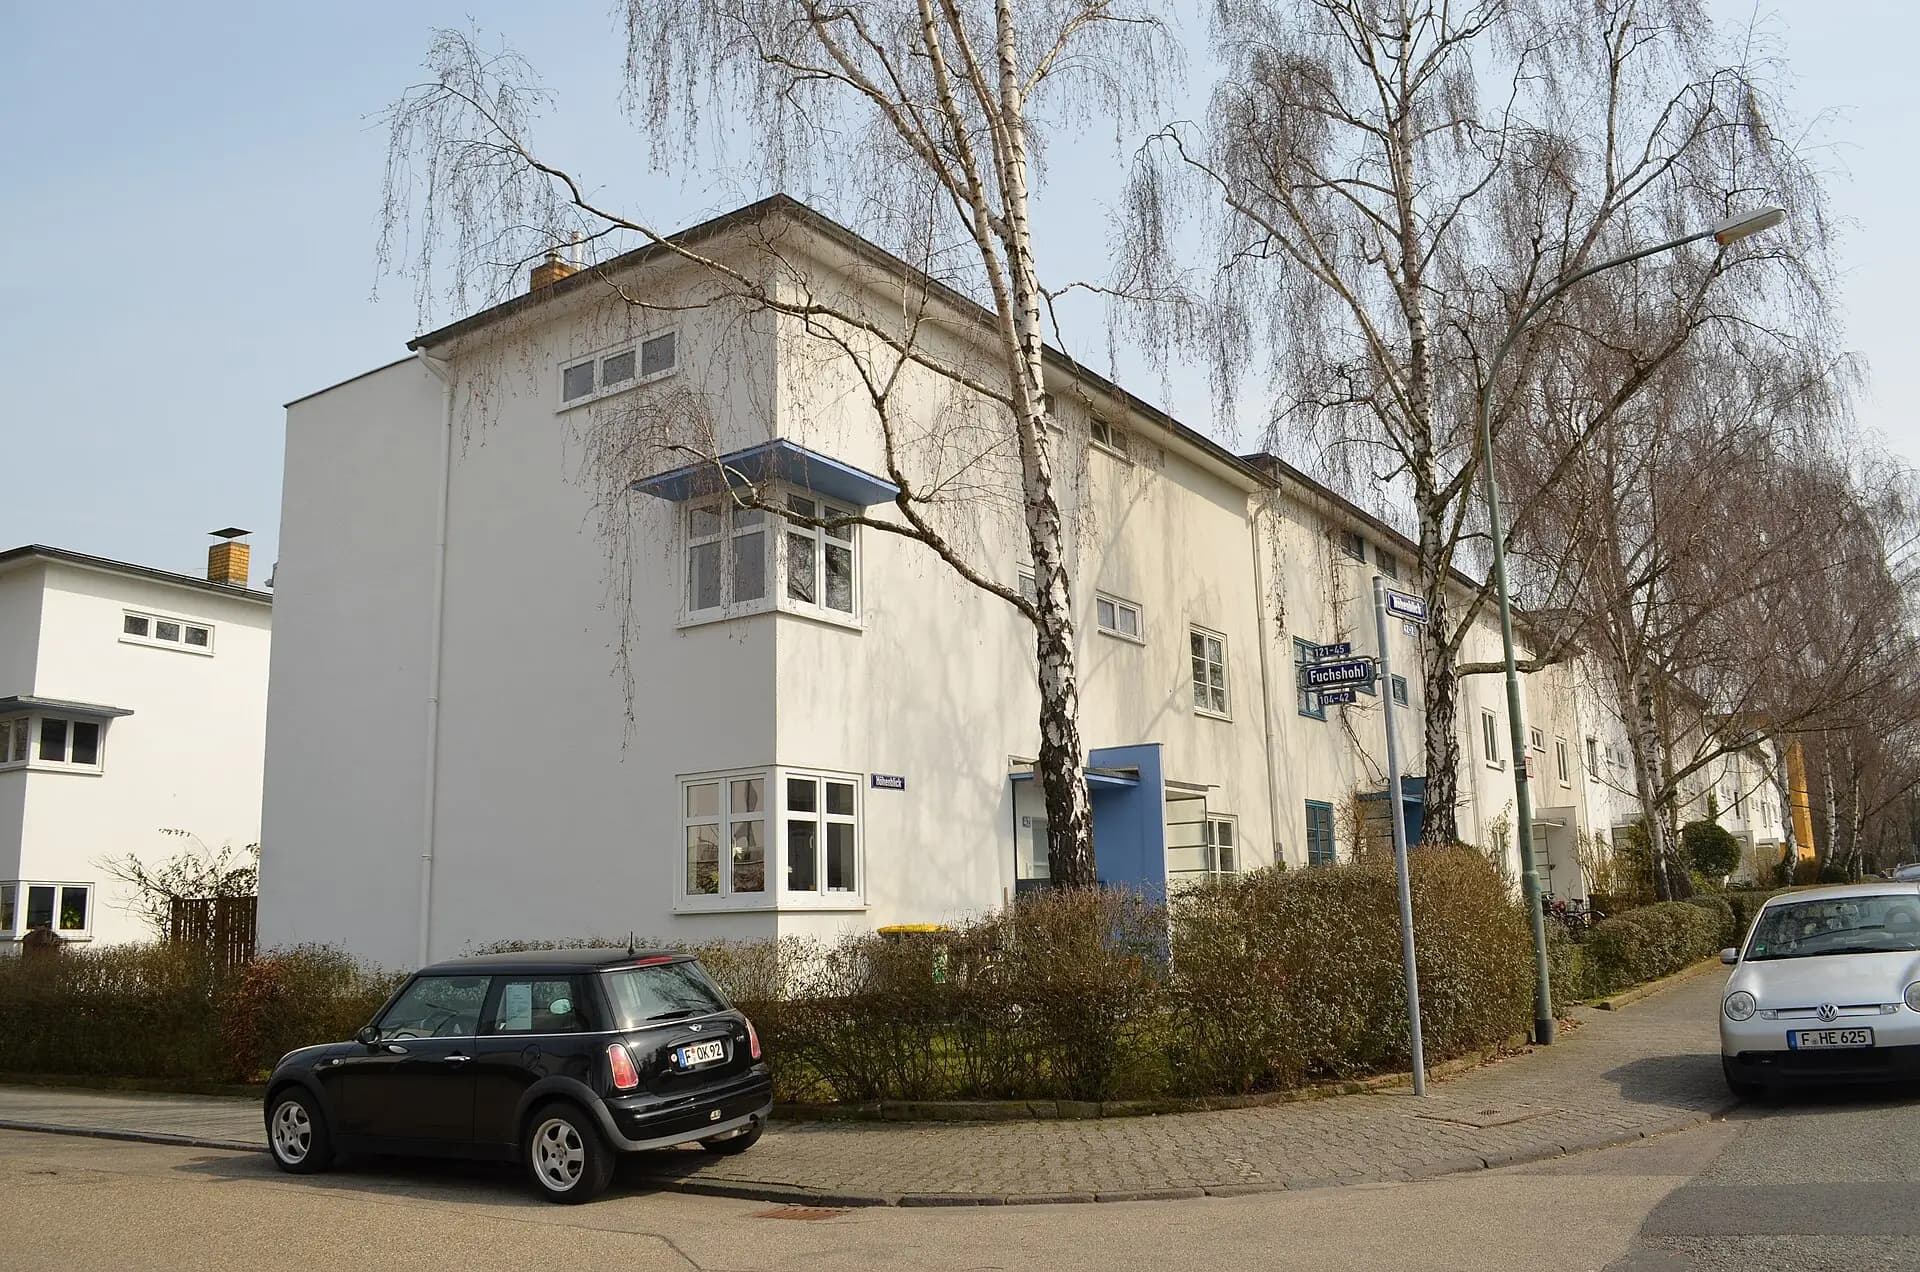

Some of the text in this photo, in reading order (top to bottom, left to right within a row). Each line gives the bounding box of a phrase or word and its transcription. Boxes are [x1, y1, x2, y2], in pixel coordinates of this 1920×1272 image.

[1315, 647, 1345, 657] 121-45
[1310, 664, 1365, 684] Fuchshohl
[1319, 692, 1350, 704] 104-42
[1817, 1003, 1838, 1021] VW
[1801, 1030, 1866, 1045] F HE 625
[685, 1043, 721, 1063] F OK 92
